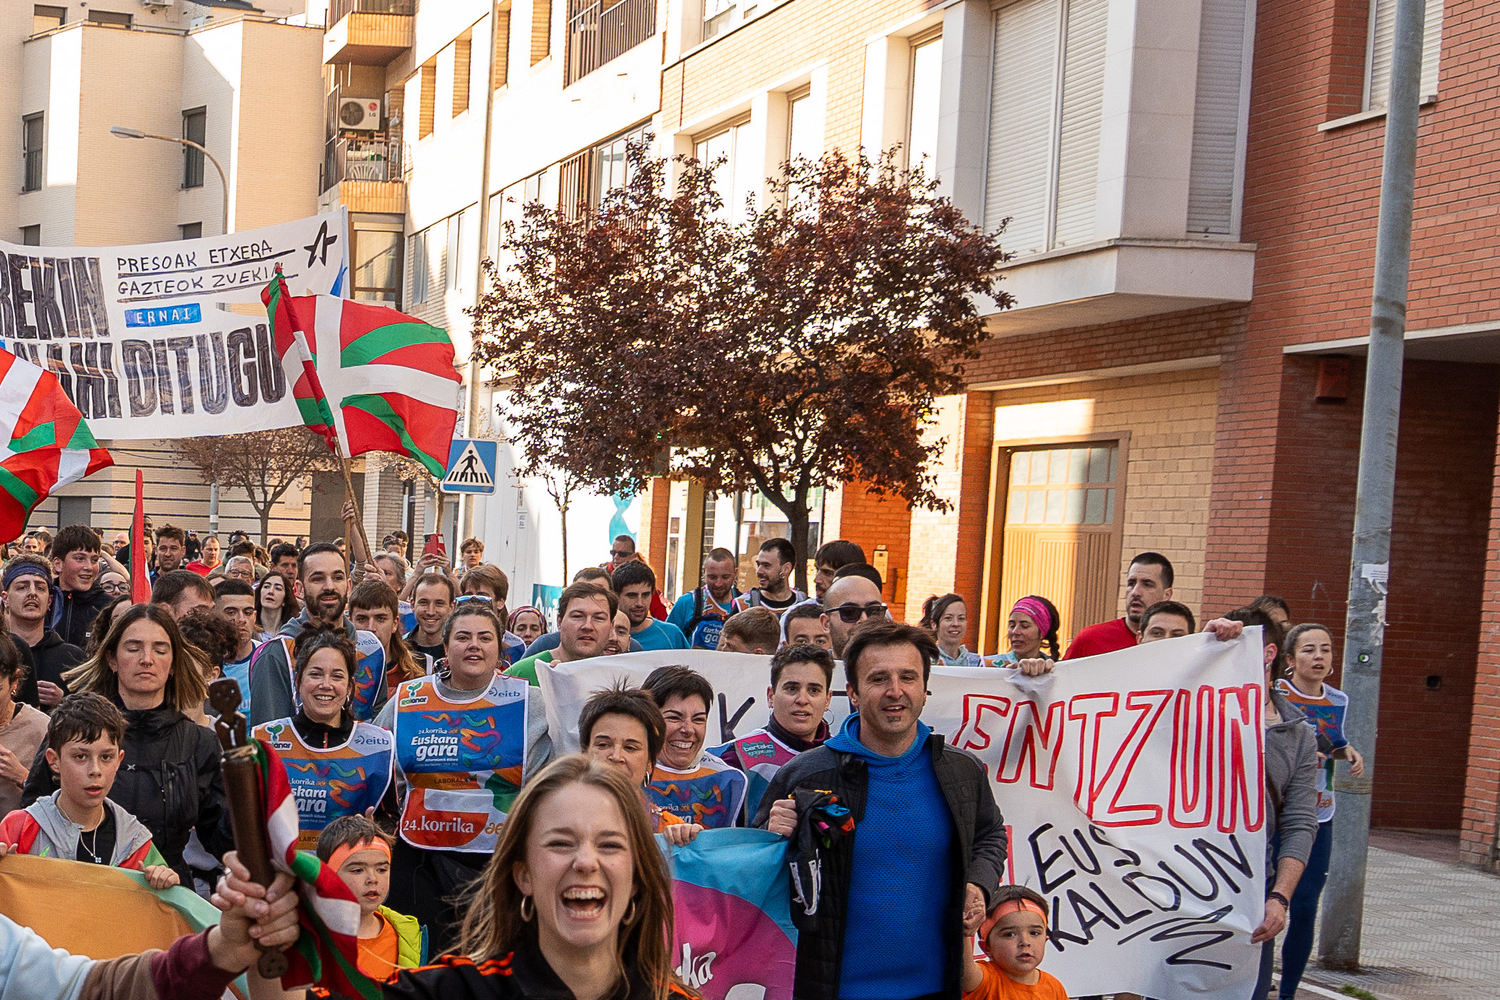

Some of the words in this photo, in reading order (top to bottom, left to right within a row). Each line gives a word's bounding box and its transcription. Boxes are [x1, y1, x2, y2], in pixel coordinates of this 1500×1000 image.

[117, 251, 197, 272] PRESOAK
[209, 239, 273, 264] ETXERA
[117, 277, 203, 296] GAZTEOK
[135, 307, 191, 325] ERNAI
[121, 323, 287, 417] DITUGU
[704, 634, 719, 643] ga
[498, 690, 521, 698] eitb
[365, 737, 390, 746] eitb
[411, 735, 459, 746] Euskara
[415, 745, 459, 762] gara
[952, 683, 1264, 833] ENTZUN
[291, 786, 327, 799] skara
[296, 799, 327, 813] ara
[402, 815, 475, 834] 24.korrika
[485, 822, 503, 836] ae
[1028, 823, 1141, 894] EUS
